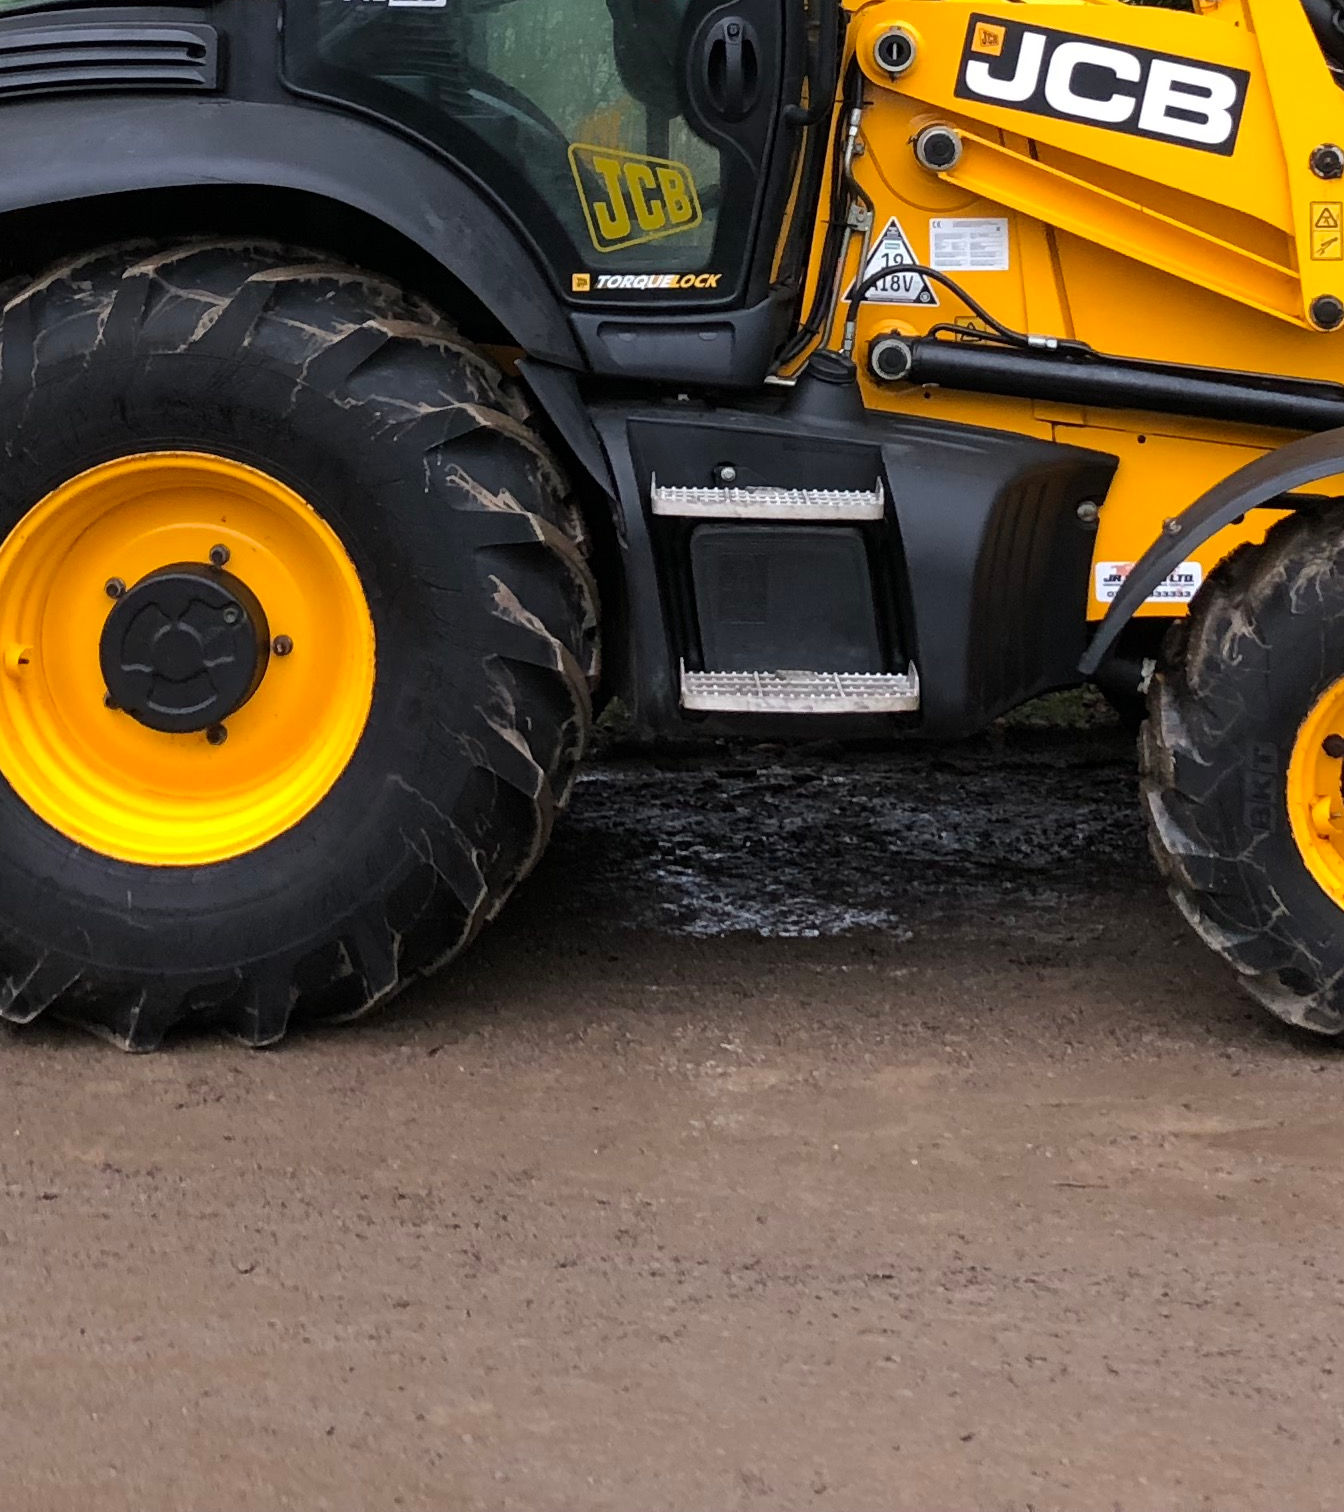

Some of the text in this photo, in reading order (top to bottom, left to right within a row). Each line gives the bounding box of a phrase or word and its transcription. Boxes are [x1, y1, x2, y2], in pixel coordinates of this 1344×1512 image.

[965, 31, 1238, 145] JCB
[592, 156, 694, 241] JCB
[881, 252, 904, 267] 19
[596, 273, 722, 290] TORQUELOCK
[873, 274, 914, 293] 18V
